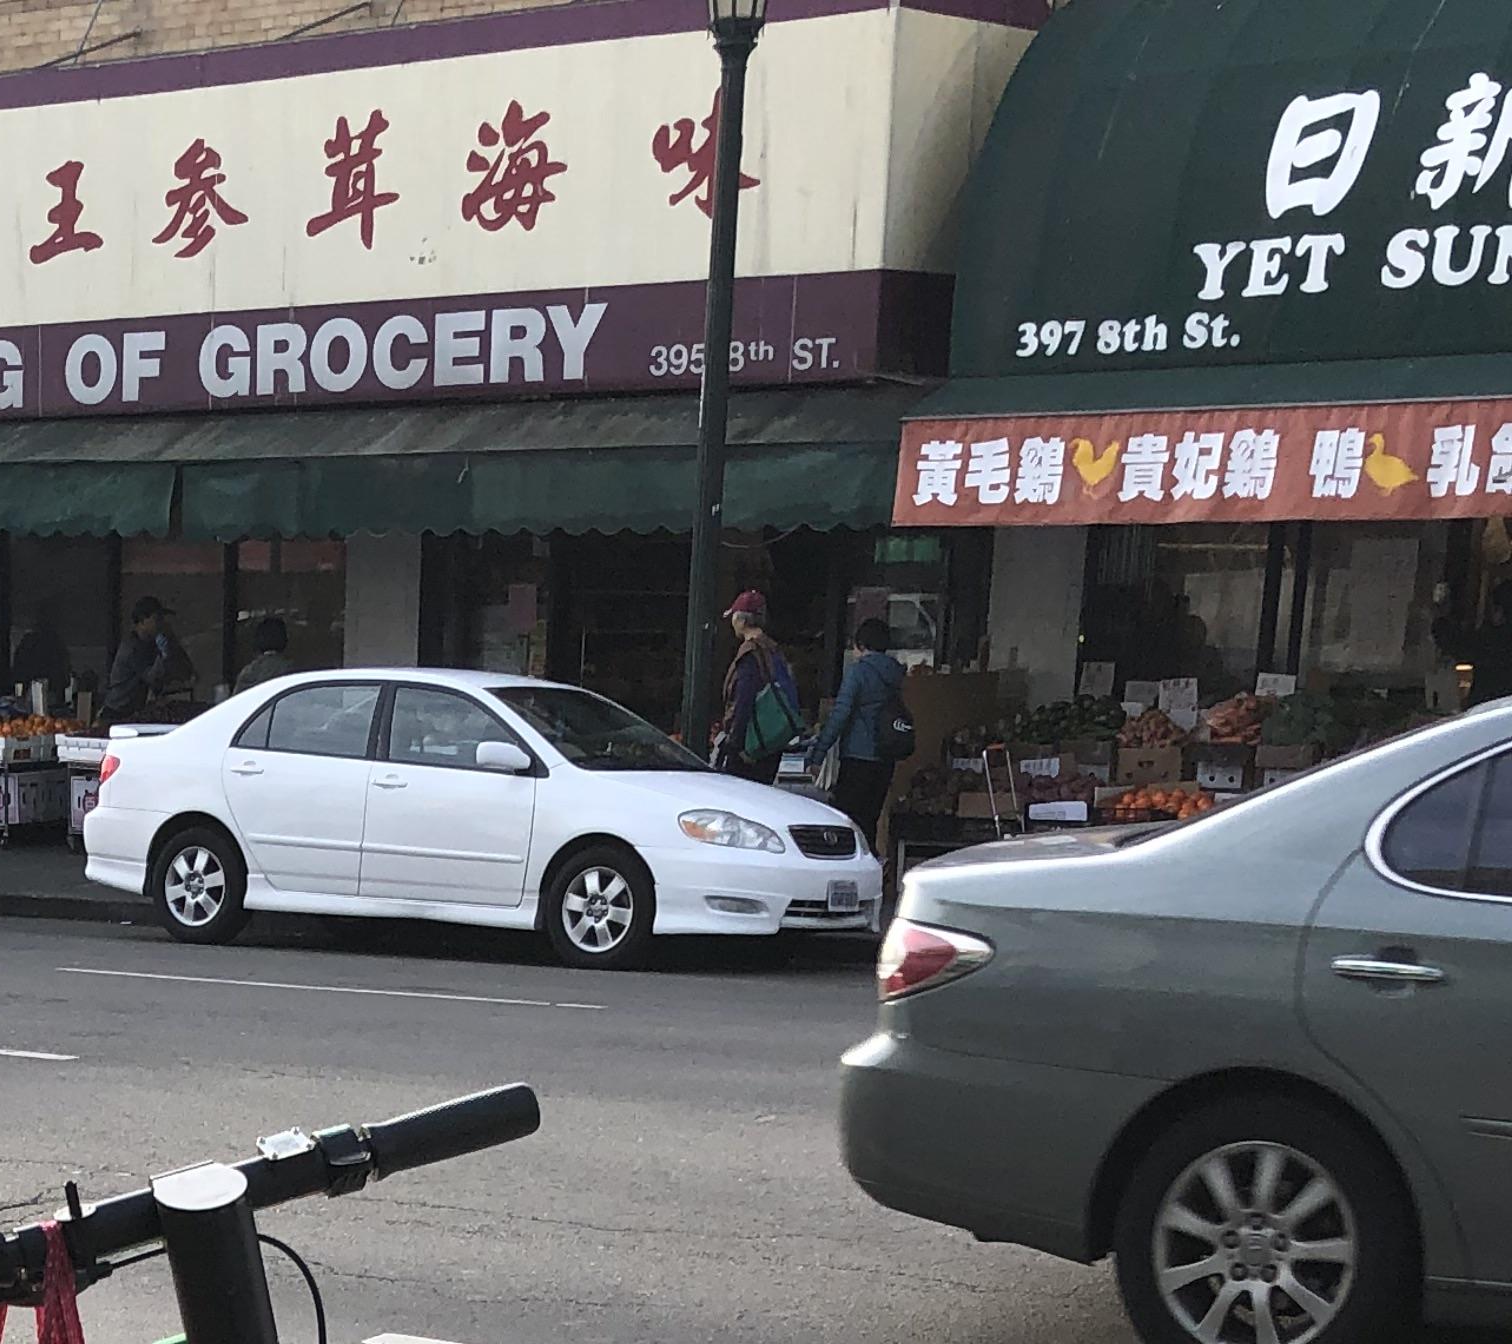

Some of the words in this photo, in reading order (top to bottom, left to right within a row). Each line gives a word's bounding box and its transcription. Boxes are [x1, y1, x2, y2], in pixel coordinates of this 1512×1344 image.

[1193, 233, 1346, 300] YET
[64, 330, 166, 406] OF
[198, 302, 609, 398] GROCERY
[792, 336, 840, 371] ST.
[1016, 320, 1086, 357] 397
[1096, 313, 1167, 355] 8th
[1182, 311, 1241, 350] St.
[1309, 427, 1366, 499] 鴨
